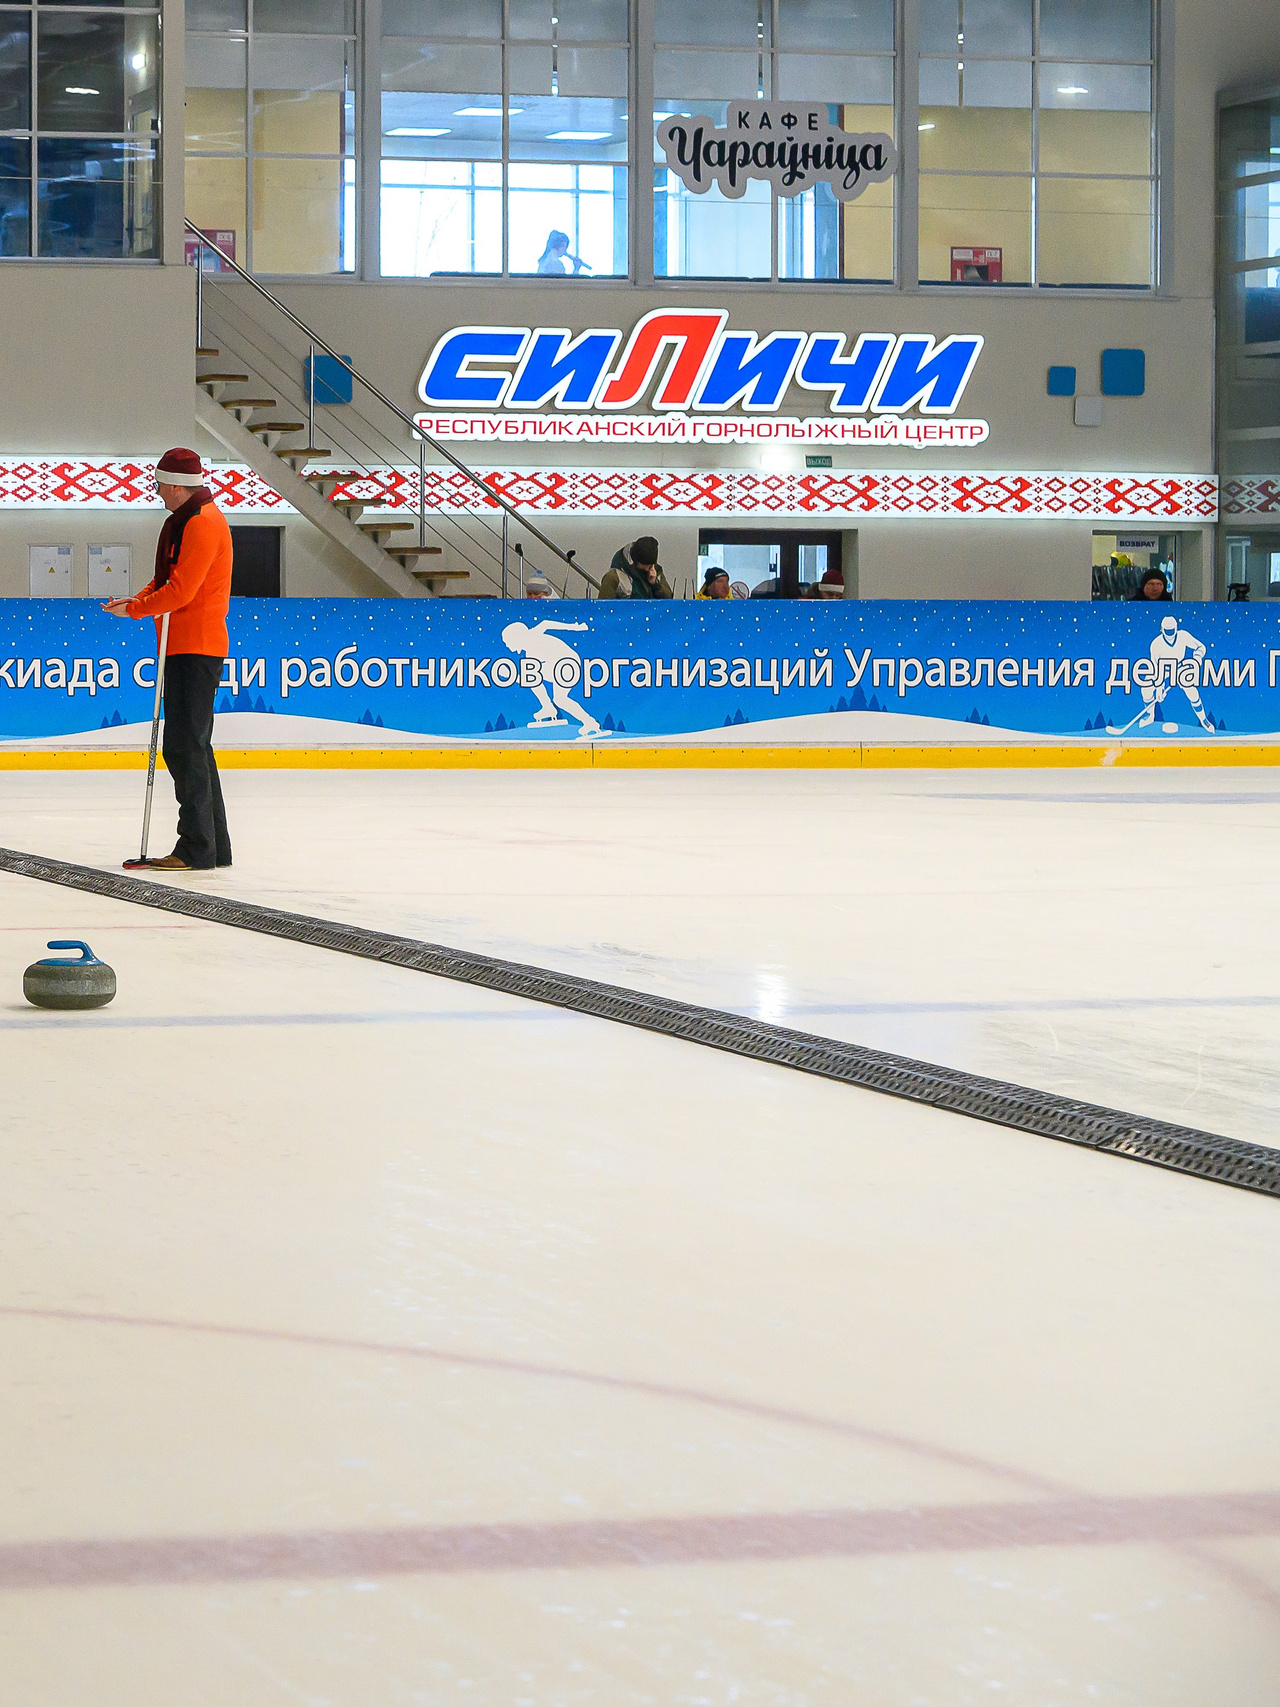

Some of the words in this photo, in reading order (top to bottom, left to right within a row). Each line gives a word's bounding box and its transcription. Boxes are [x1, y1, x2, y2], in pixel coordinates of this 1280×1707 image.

[738, 111, 819, 131] КАФЕ
[668, 126, 888, 190] Чараўніца
[419, 418, 686, 437] РЕСПУБЛИКАНСКИЙ
[692, 421, 898, 440] ГОРНОЛЫЖНЫЙ
[905, 424, 984, 442] ЦЕНТР
[1119, 540, 1156, 548] ВОЗВРАТ
[280, 645, 544, 698] работников
[552, 647, 834, 698] организаций
[844, 647, 1095, 697] Управления
[1105, 656, 1257, 695] делами
